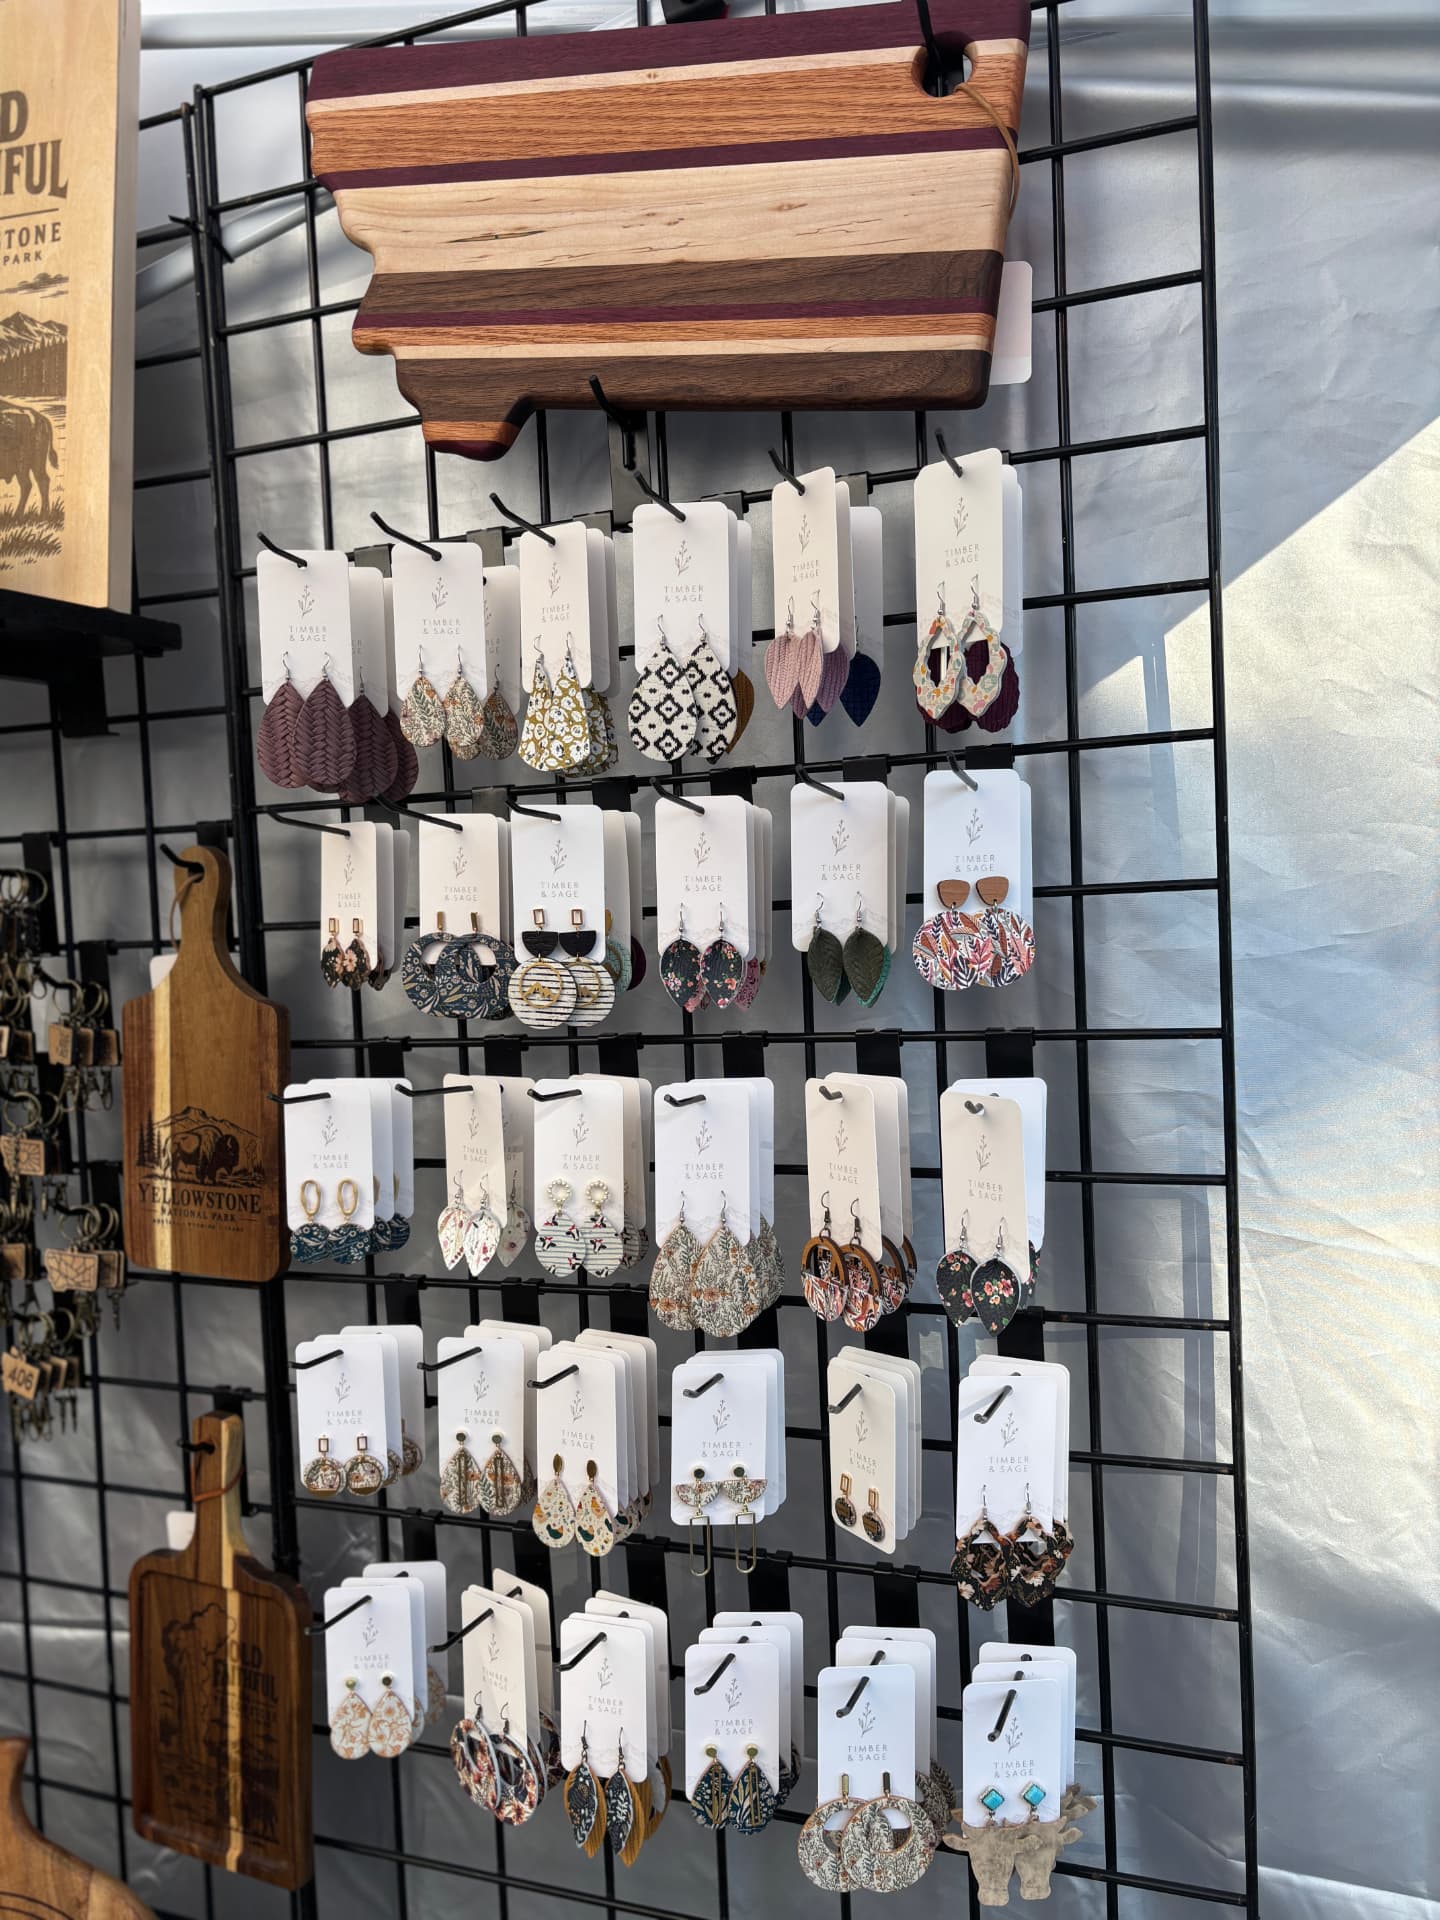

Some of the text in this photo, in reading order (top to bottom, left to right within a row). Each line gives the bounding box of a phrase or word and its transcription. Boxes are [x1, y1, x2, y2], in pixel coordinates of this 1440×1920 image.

[0, 139, 69, 199] FUL
[0, 222, 61, 249] TONE
[3, 250, 42, 265] PARK
[944, 544, 980, 556] TIMBER
[954, 554, 979, 566] SAGE
[792, 560, 821, 572] TIMBER
[664, 585, 704, 593] TIMBER
[674, 594, 703, 602] SAGE
[541, 605, 571, 615] TIMBER
[289, 625, 327, 633] TIMBER
[433, 627, 461, 635] SAGE
[299, 634, 327, 642] SAGE
[954, 854, 996, 863] TIMBER
[821, 864, 861, 872] TIMBER
[965, 864, 995, 872] SAGE
[684, 875, 723, 883] TIMBER
[832, 873, 861, 881] SAGE
[444, 886, 478, 894] TIMBER
[694, 884, 722, 892] SAGE
[452, 894, 478, 902] SAGE
[551, 890, 579, 898] SAGE
[312, 1153, 350, 1161] TIMBER
[562, 1154, 600, 1162] TIMBER
[572, 1162, 600, 1170] SAGE
[684, 1163, 725, 1171] TIMBER
[829, 1162, 859, 1175] TIMBER
[694, 1172, 724, 1180] SAGE
[968, 1179, 1004, 1193] TIMBER
[139, 1183, 262, 1214] YELLOWSTONE
[8, 1367, 33, 1391] 406
[327, 1410, 362, 1418] TIMBER
[464, 1408, 501, 1417] TIMBER
[473, 1417, 499, 1425] SAGE
[562, 1429, 596, 1441] TIMBER
[702, 1441, 742, 1449] TIMBER
[711, 1450, 742, 1458] SAGE
[849, 1448, 878, 1466] TIMBER
[989, 1455, 1030, 1464] TIMBER
[999, 1465, 1029, 1473] SAGE
[354, 1654, 390, 1662] TIMBER
[589, 1696, 624, 1707] TIMBER
[714, 1719, 754, 1727] TIMBER
[724, 1727, 753, 1735] SAGE
[847, 1744, 888, 1753] TIMBER
[858, 1753, 888, 1762] SAGE
[993, 1760, 1035, 1769] TIMBER
[1004, 1769, 1034, 1777] SAGE
